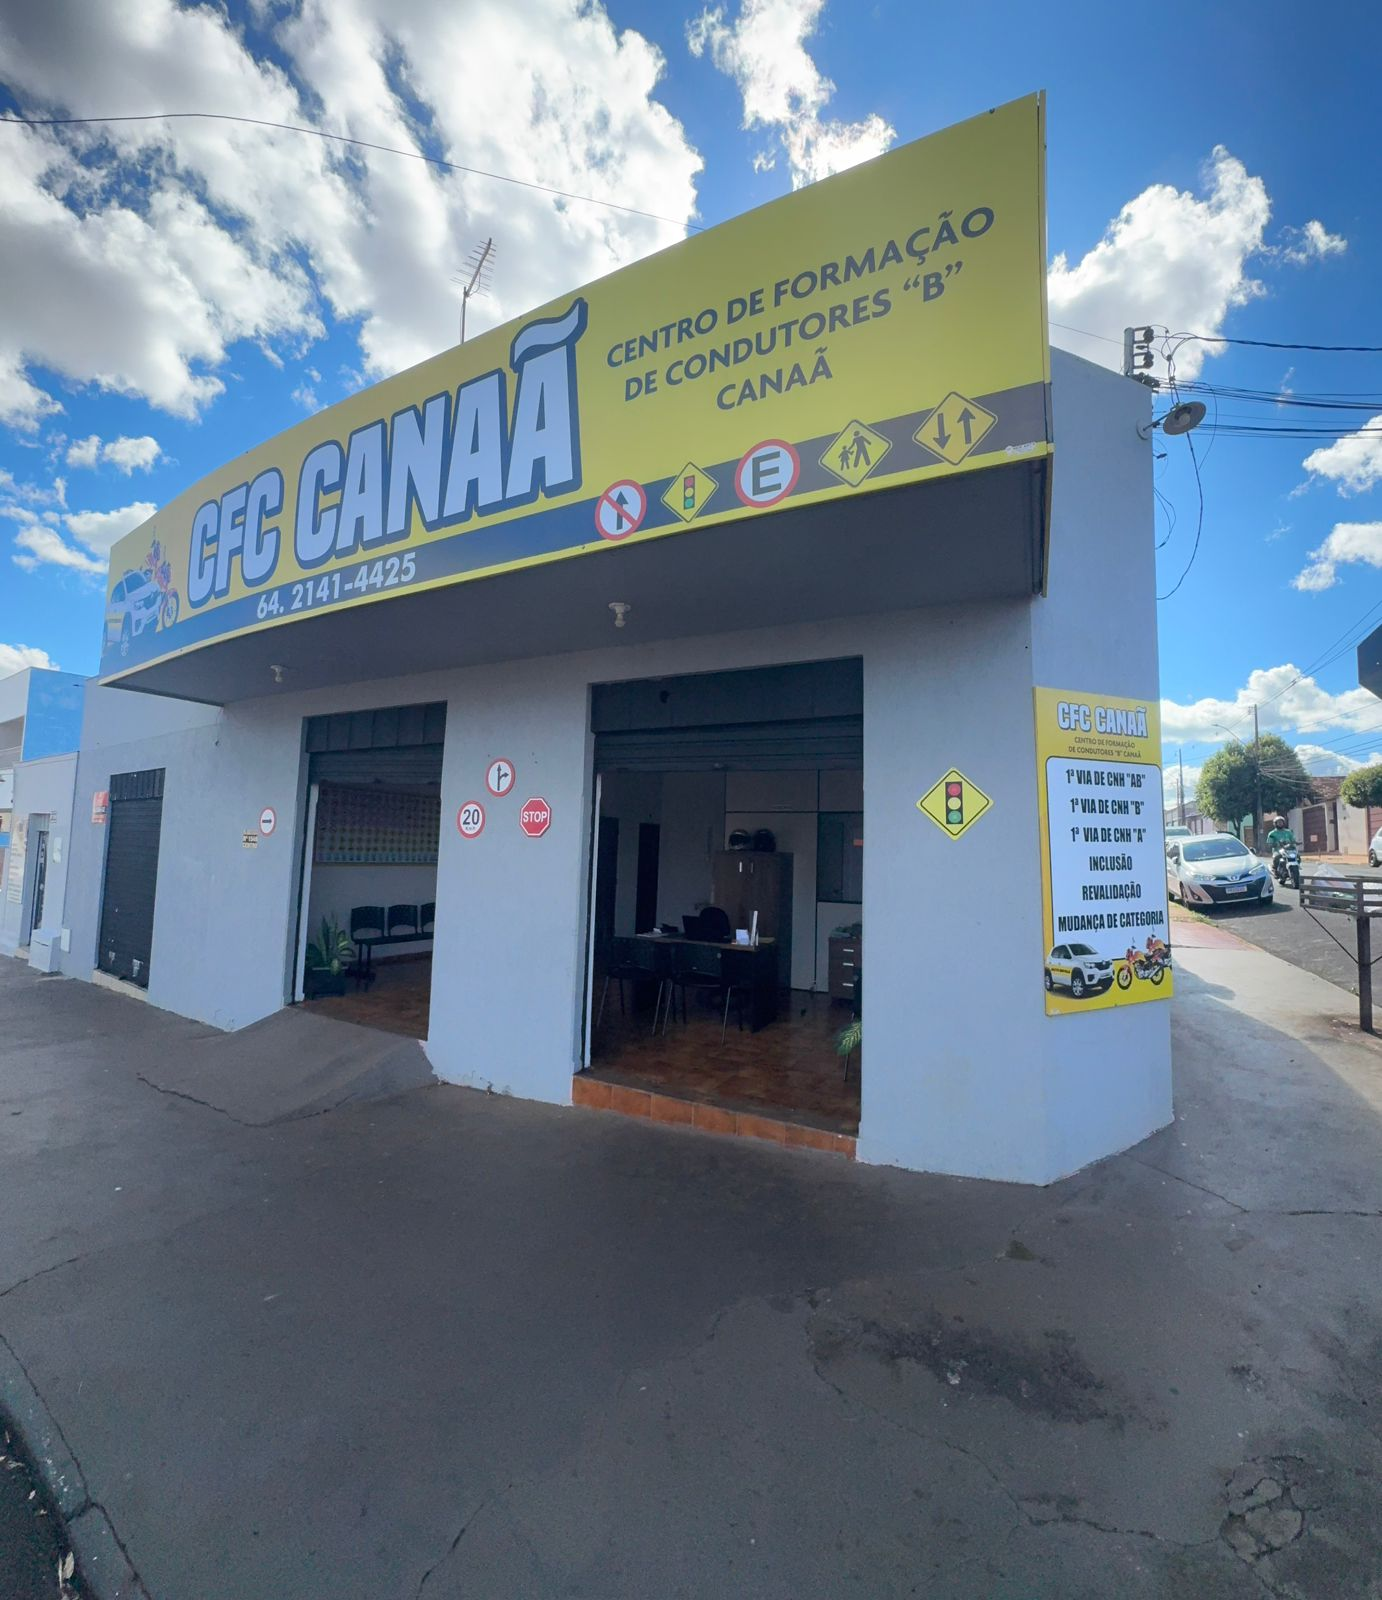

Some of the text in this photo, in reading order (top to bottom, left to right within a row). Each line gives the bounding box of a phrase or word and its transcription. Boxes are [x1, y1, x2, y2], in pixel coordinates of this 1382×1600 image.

[607, 207, 995, 368] CENTRO DE FORMAÇÃO
[624, 369, 658, 402] DE
[666, 288, 893, 386] CONDUTORES
[716, 346, 833, 410] CANAÃ
[187, 298, 587, 607] CFC CANAÃ
[257, 551, 416, 619] 64. 2141-4425
[1057, 701, 1148, 738] CFC CANAÃ
[1074, 736, 1135, 749] CENTRO DE FORMAÇÃO
[1077, 747, 1114, 756] CONDUTORES
[1124, 750, 1141, 759] CANAÃ
[1076, 769, 1092, 785] VIA
[1094, 770, 1105, 786] DE
[1107, 772, 1125, 787] CNH
[1127, 773, 1146, 788] "AB"
[1080, 798, 1096, 814] VIA
[1098, 799, 1109, 814] DE
[1111, 799, 1129, 815] CNH
[1131, 801, 1144, 815] "B"
[462, 809, 480, 825] 20
[522, 811, 547, 823] STOP
[1083, 827, 1099, 843] VIA
[1101, 827, 1112, 842] DE
[1114, 828, 1131, 842] CNH
[1133, 828, 1146, 843] "A"
[1089, 853, 1133, 871] INCLUSÃO
[1082, 881, 1141, 902] REVALIDAÇÃO
[1058, 910, 1164, 933] MUDANÇA DE CATEGORIA
